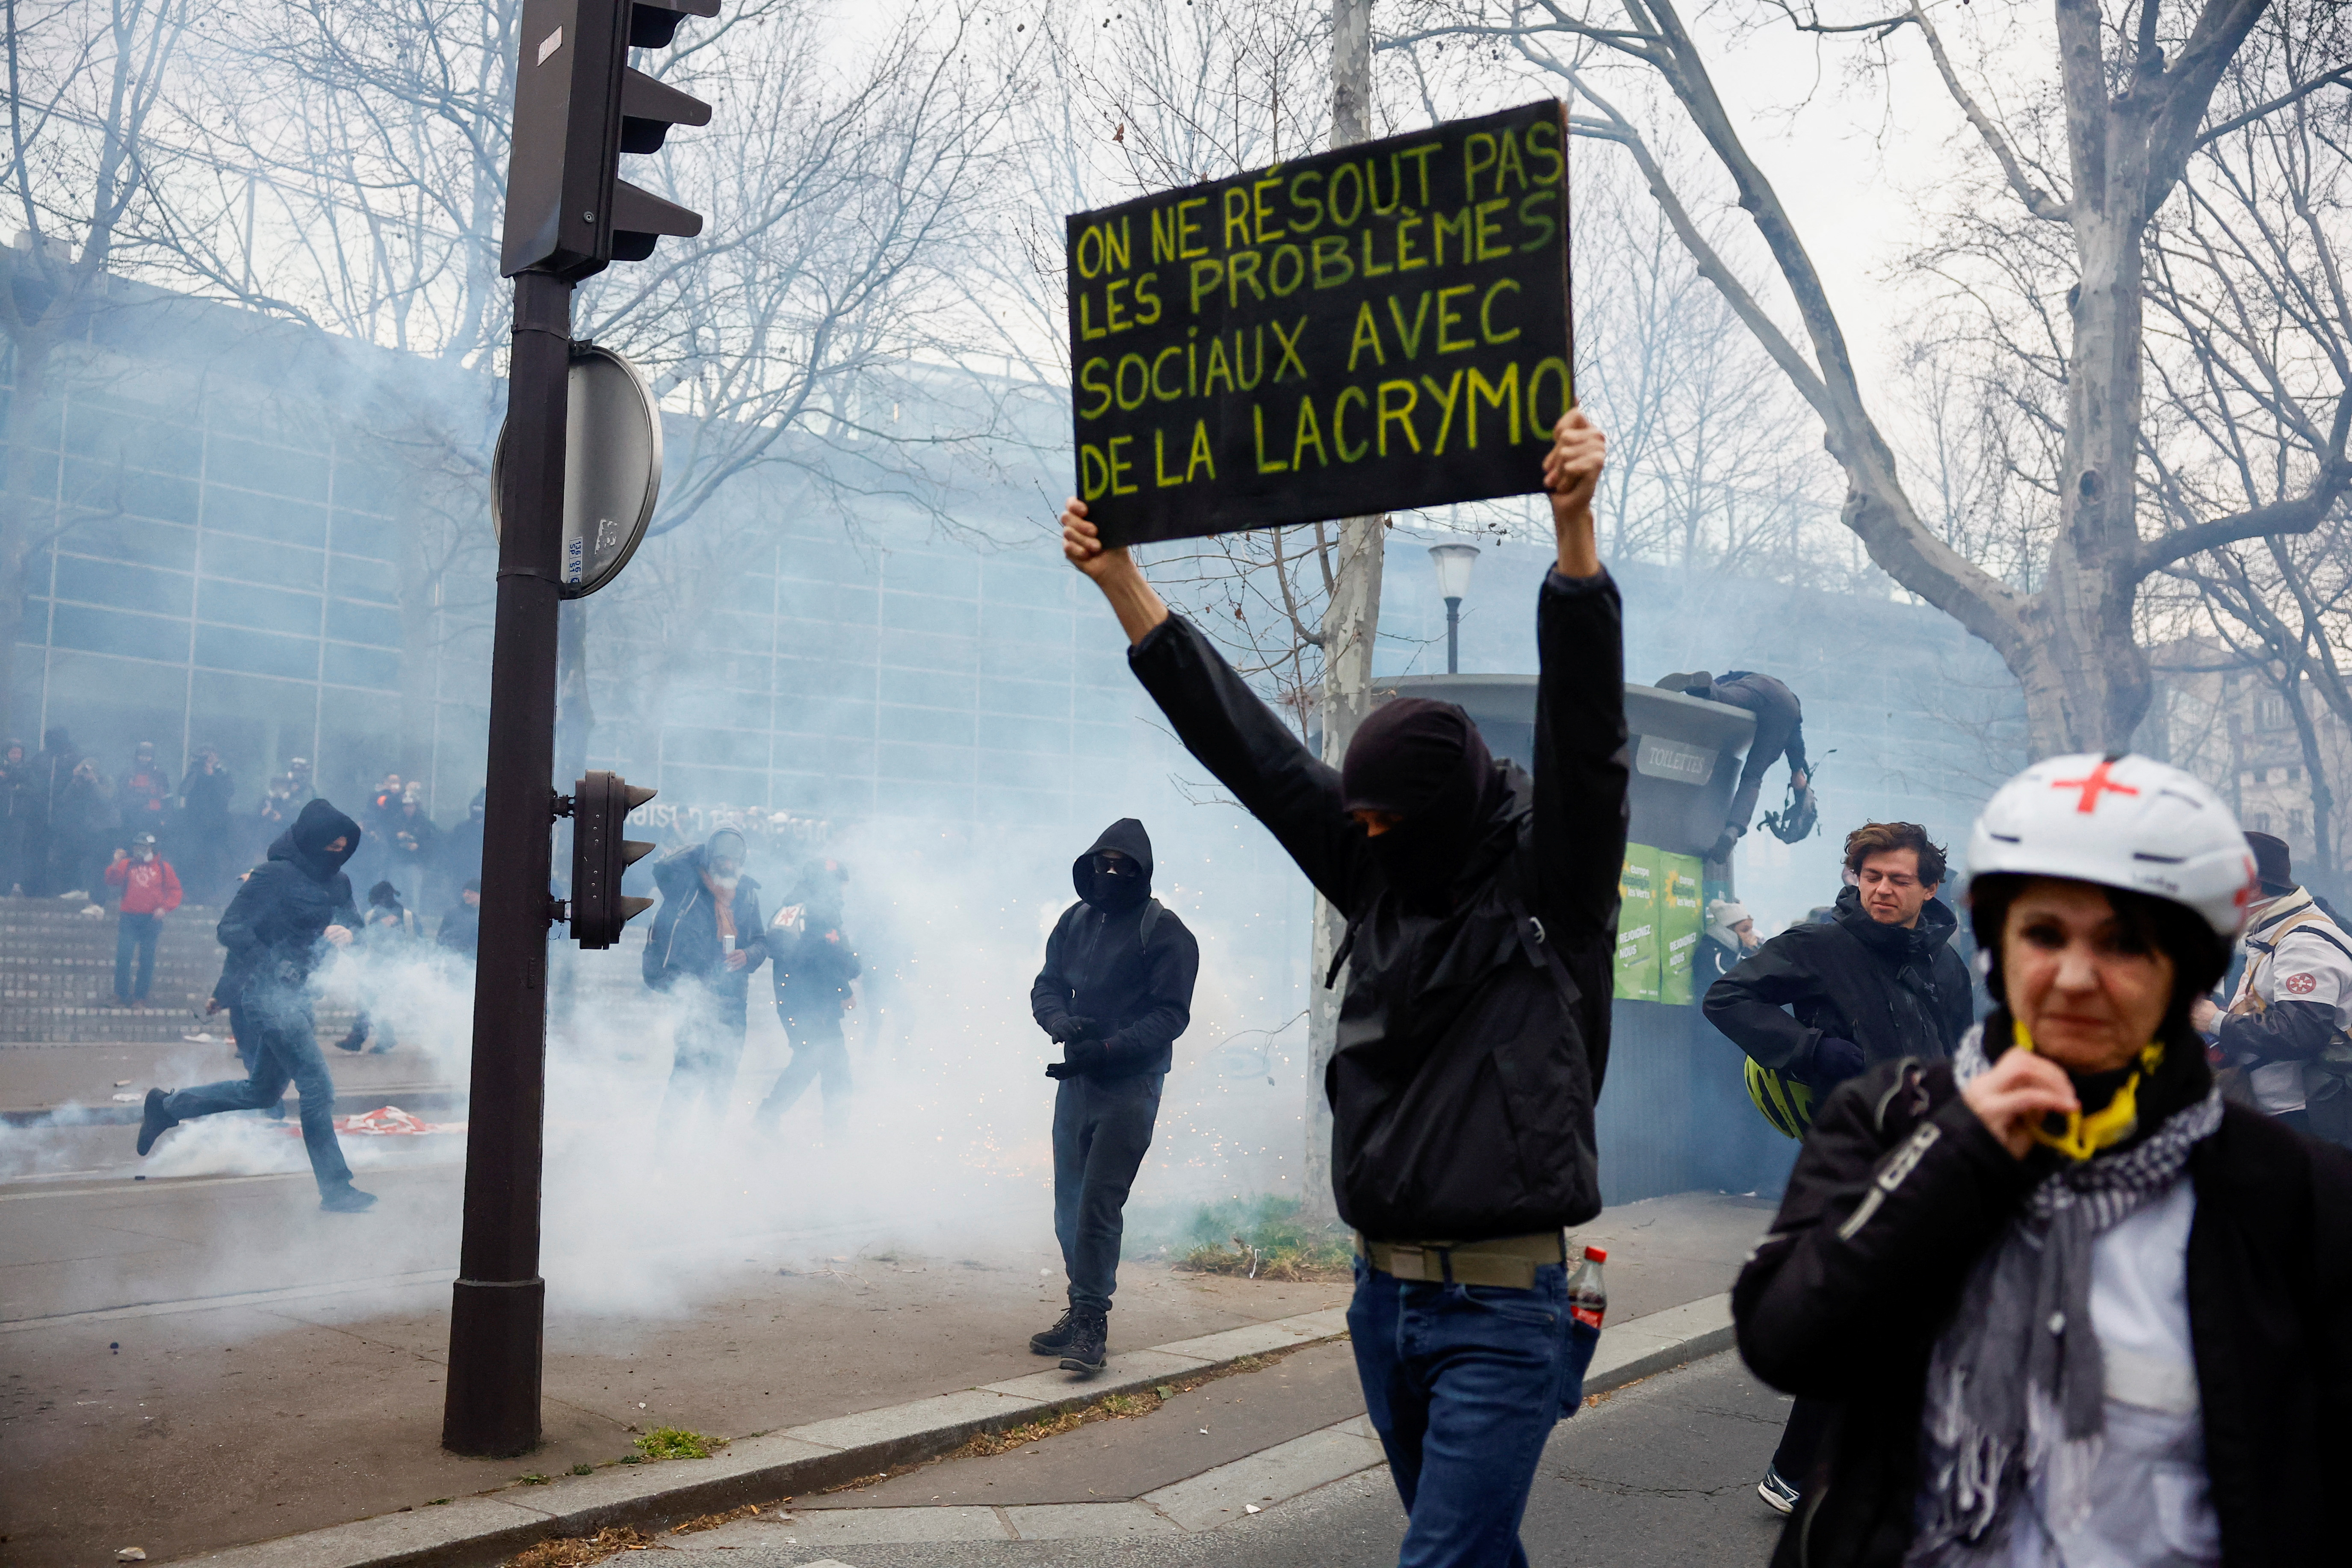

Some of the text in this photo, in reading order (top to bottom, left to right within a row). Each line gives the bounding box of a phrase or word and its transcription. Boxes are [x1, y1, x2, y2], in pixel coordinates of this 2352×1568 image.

[1077, 121, 1565, 279] ON NE RÉSOUT PAS
[1080, 192, 1557, 341] LES PROBLÈMES
[1348, 278, 1521, 372] AVEC
[1081, 357, 1574, 502] DE LA LACRYMO
[570, 544, 576, 555] SP
[570, 563, 575, 572] 51
[575, 561, 581, 573] 06
[1649, 747, 1705, 774] TOILETTES
[1619, 924, 1651, 944] REJOIGNEZ
[1619, 944, 1637, 959] NOUS
